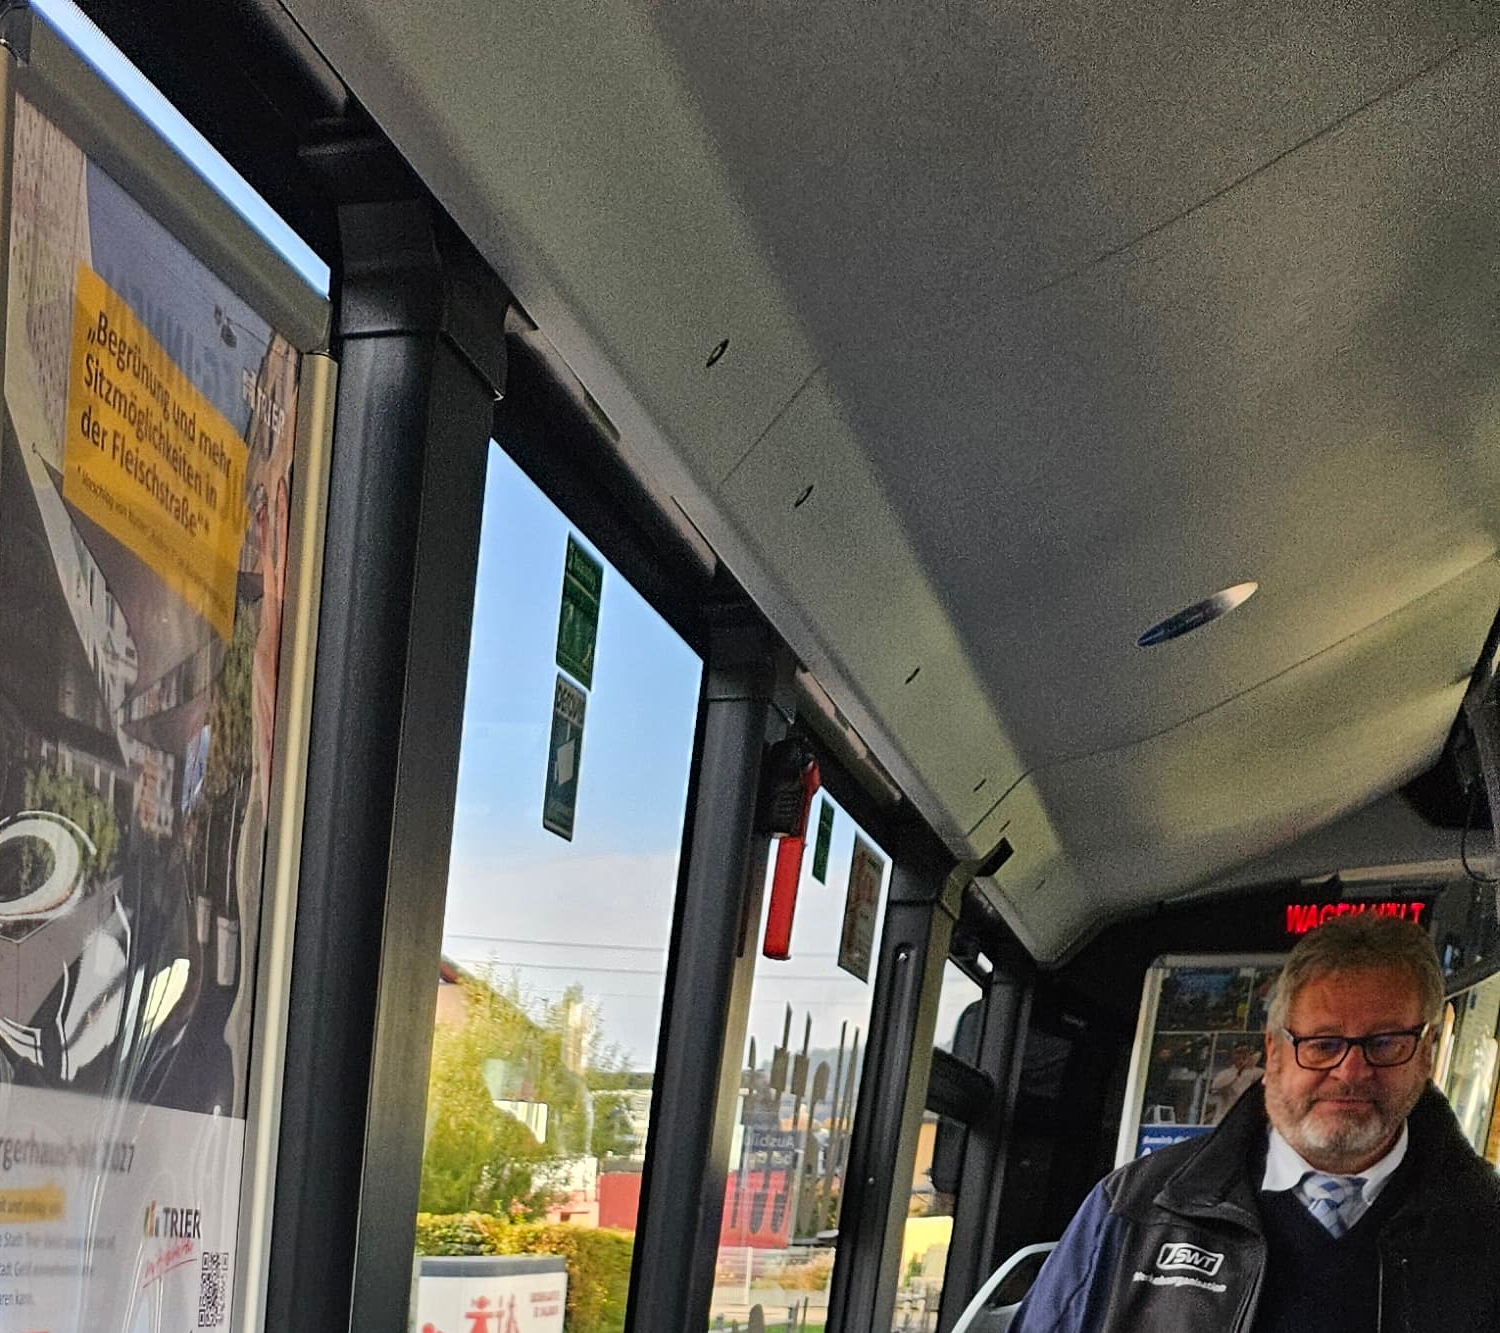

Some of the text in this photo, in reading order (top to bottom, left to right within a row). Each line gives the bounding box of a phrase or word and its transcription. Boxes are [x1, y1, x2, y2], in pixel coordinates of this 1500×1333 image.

[80, 404, 109, 452] der
[83, 352, 203, 497] Sitzmöglichkeiten
[172, 400, 196, 442] und
[199, 430, 232, 478] mehr
[163, 1207, 201, 1239] TRIER
